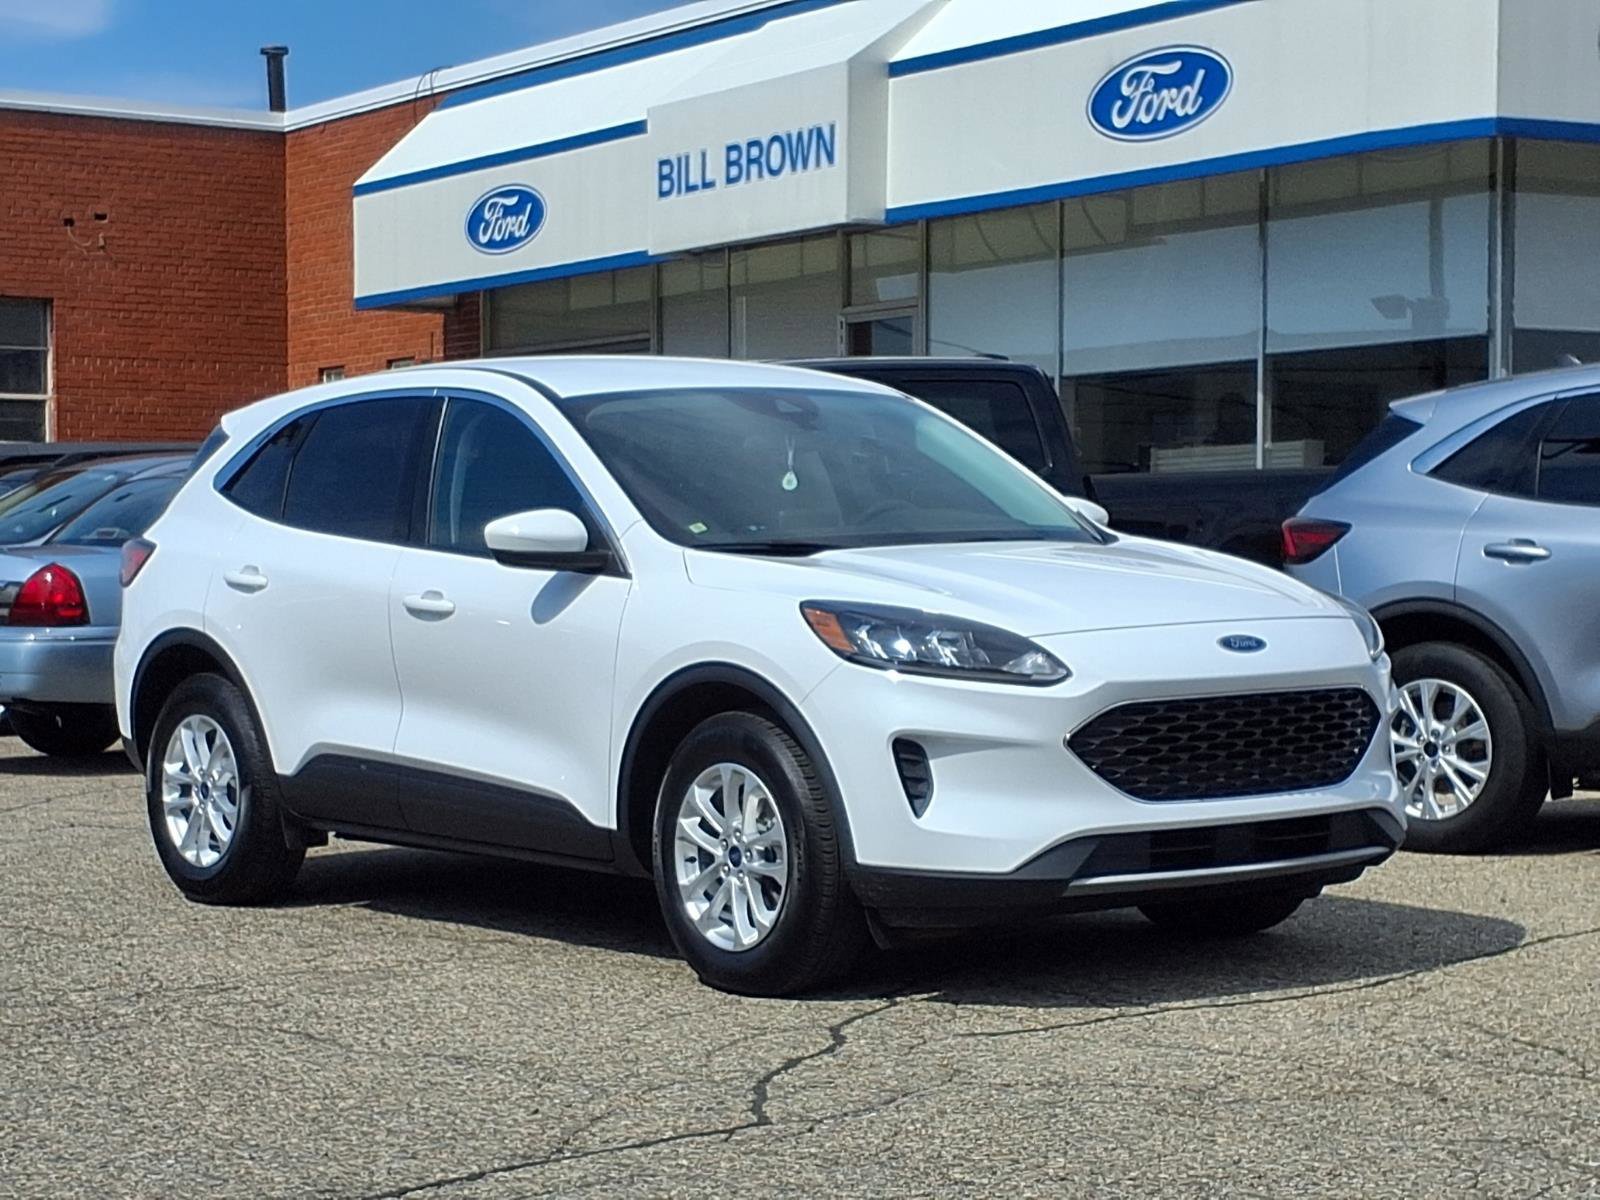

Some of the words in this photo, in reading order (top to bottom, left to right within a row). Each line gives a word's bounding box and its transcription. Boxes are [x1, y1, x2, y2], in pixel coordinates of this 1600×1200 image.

[1111, 59, 1206, 129] Ford
[657, 150, 716, 199] BILL
[725, 122, 836, 186] BROWN
[478, 194, 533, 244] Ford
